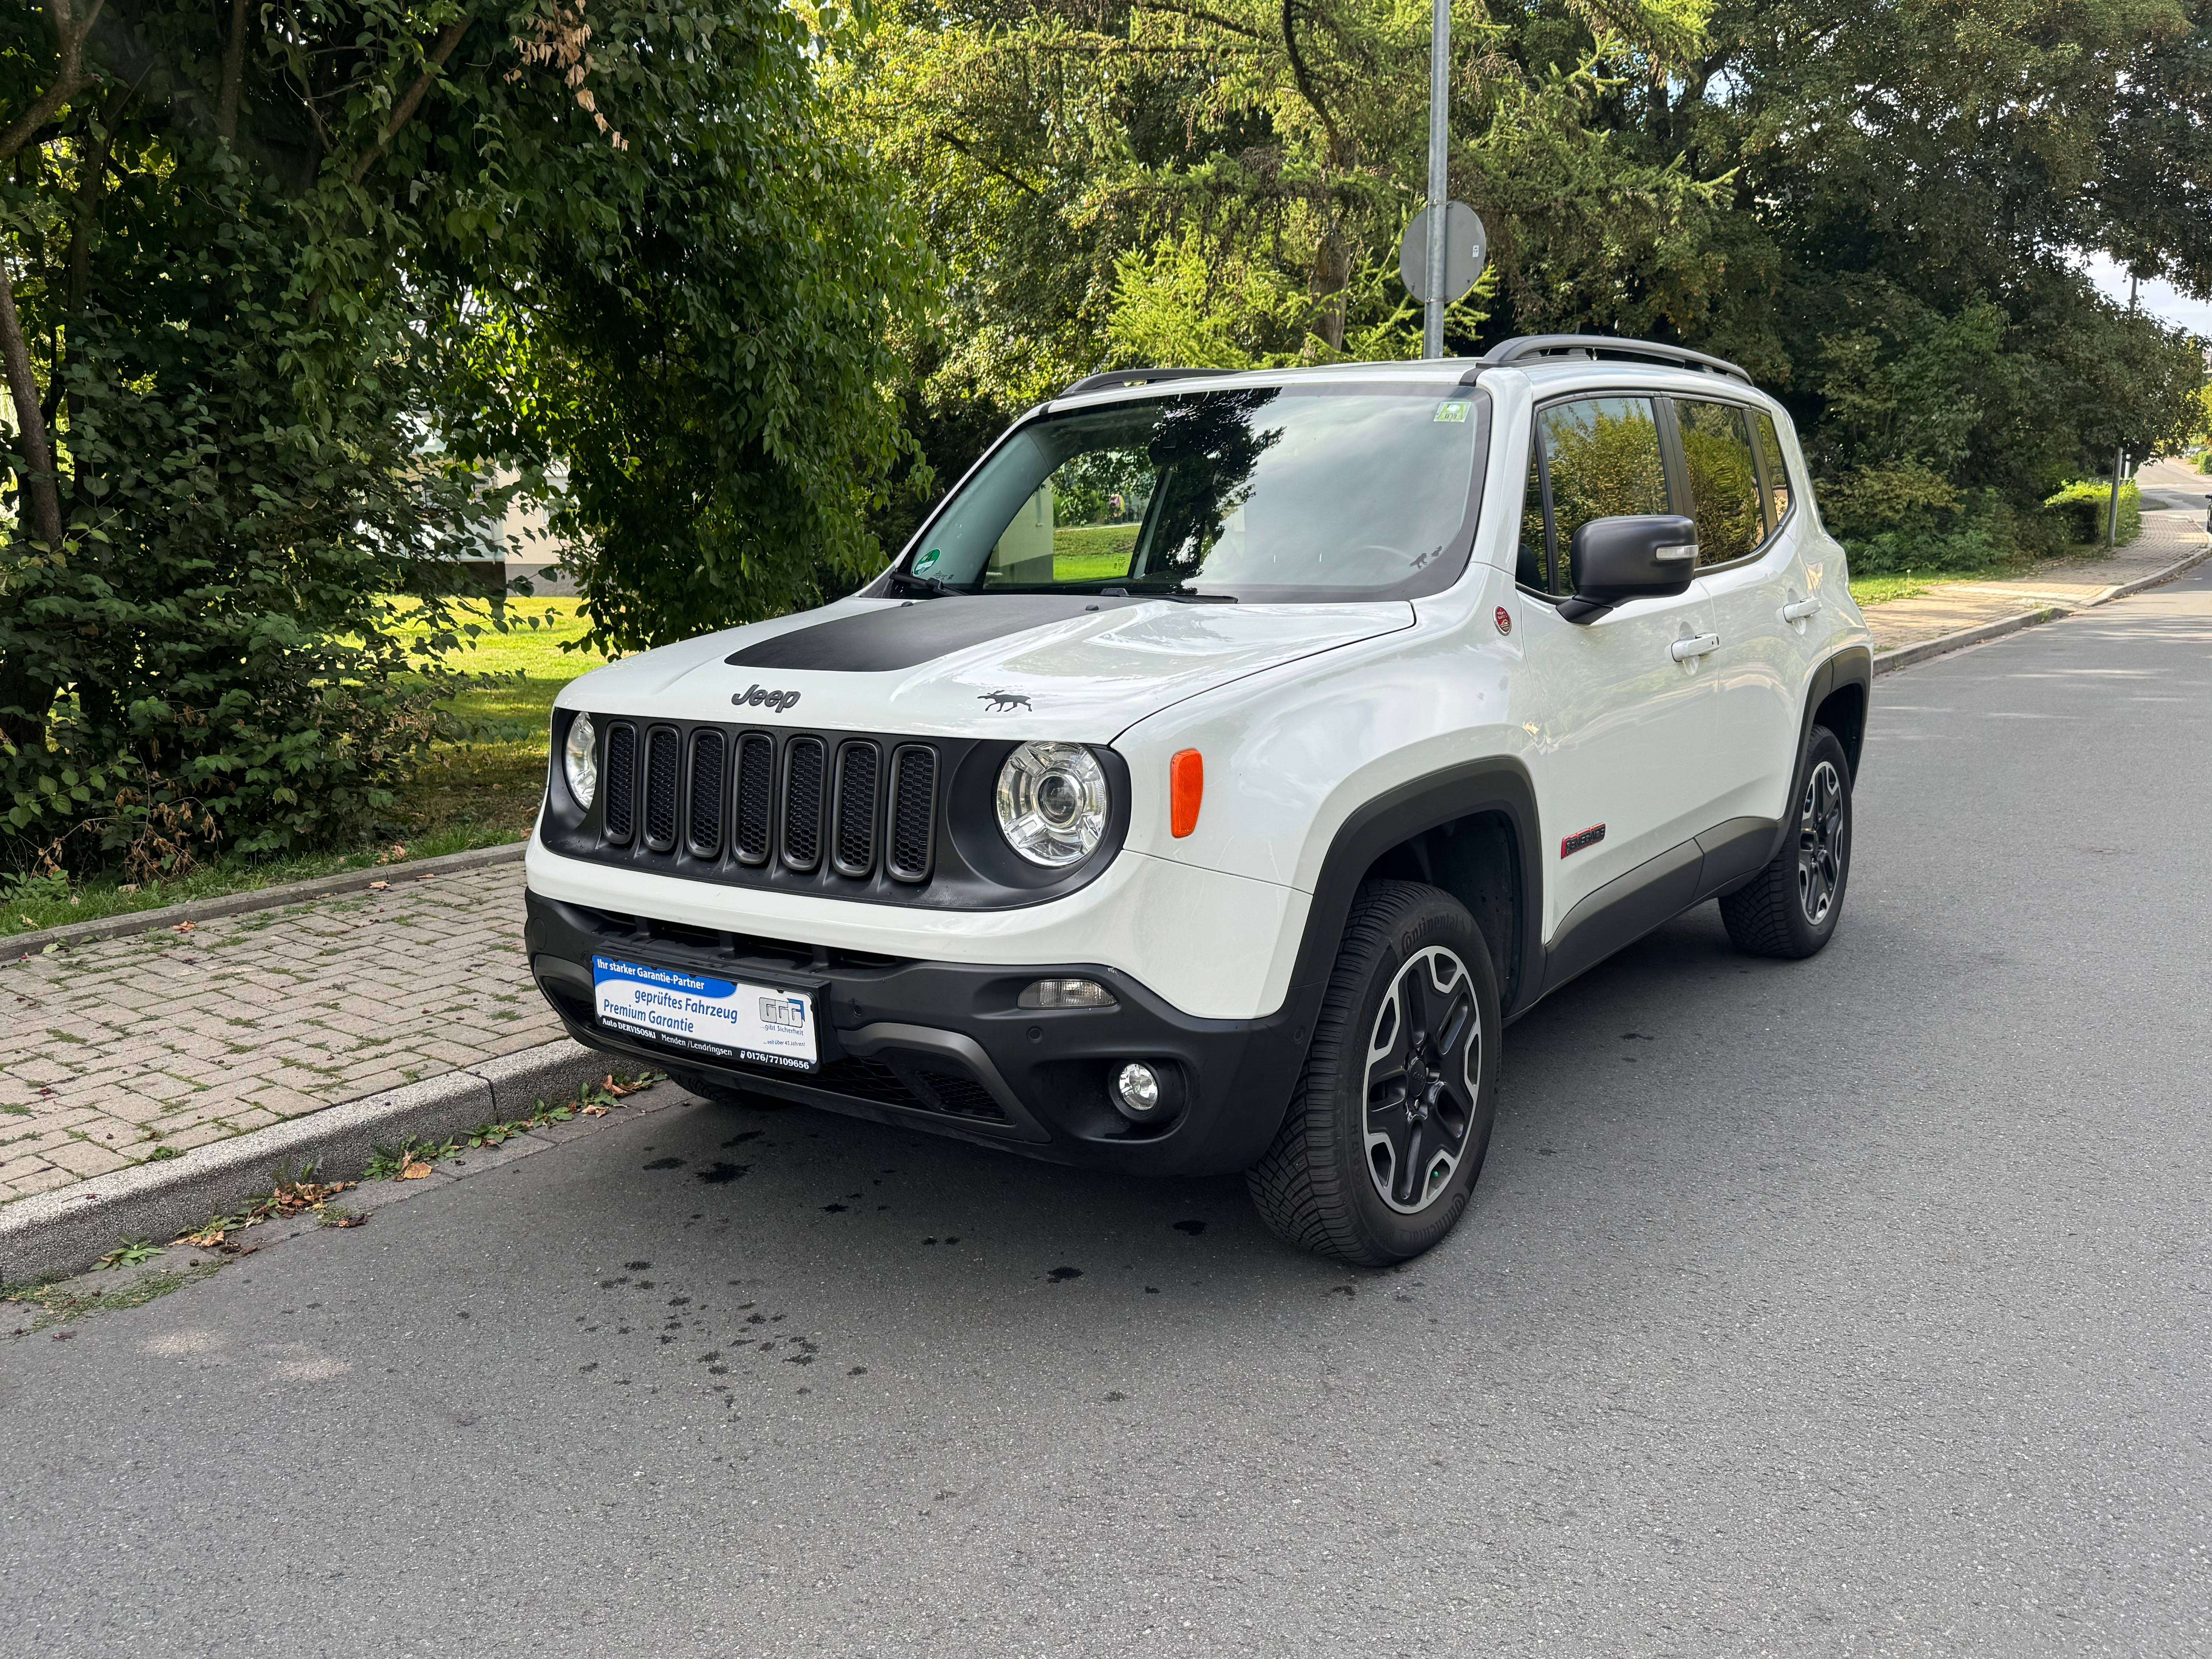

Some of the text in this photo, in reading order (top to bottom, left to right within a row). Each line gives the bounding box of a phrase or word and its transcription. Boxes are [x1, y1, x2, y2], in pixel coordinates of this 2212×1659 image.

[731, 684, 801, 713] Jeep
[597, 958, 705, 989] Ihr starker Garantie-Partner
[604, 999, 694, 1033] Premium Garantie
[635, 989, 738, 1024] geprüftes Fahrzeug
[603, 1018, 617, 1028] Auto
[661, 1034, 686, 1046] Menden
[747, 1051, 809, 1070] 0176/77109656
[777, 1025, 804, 1036] Sicherheit
